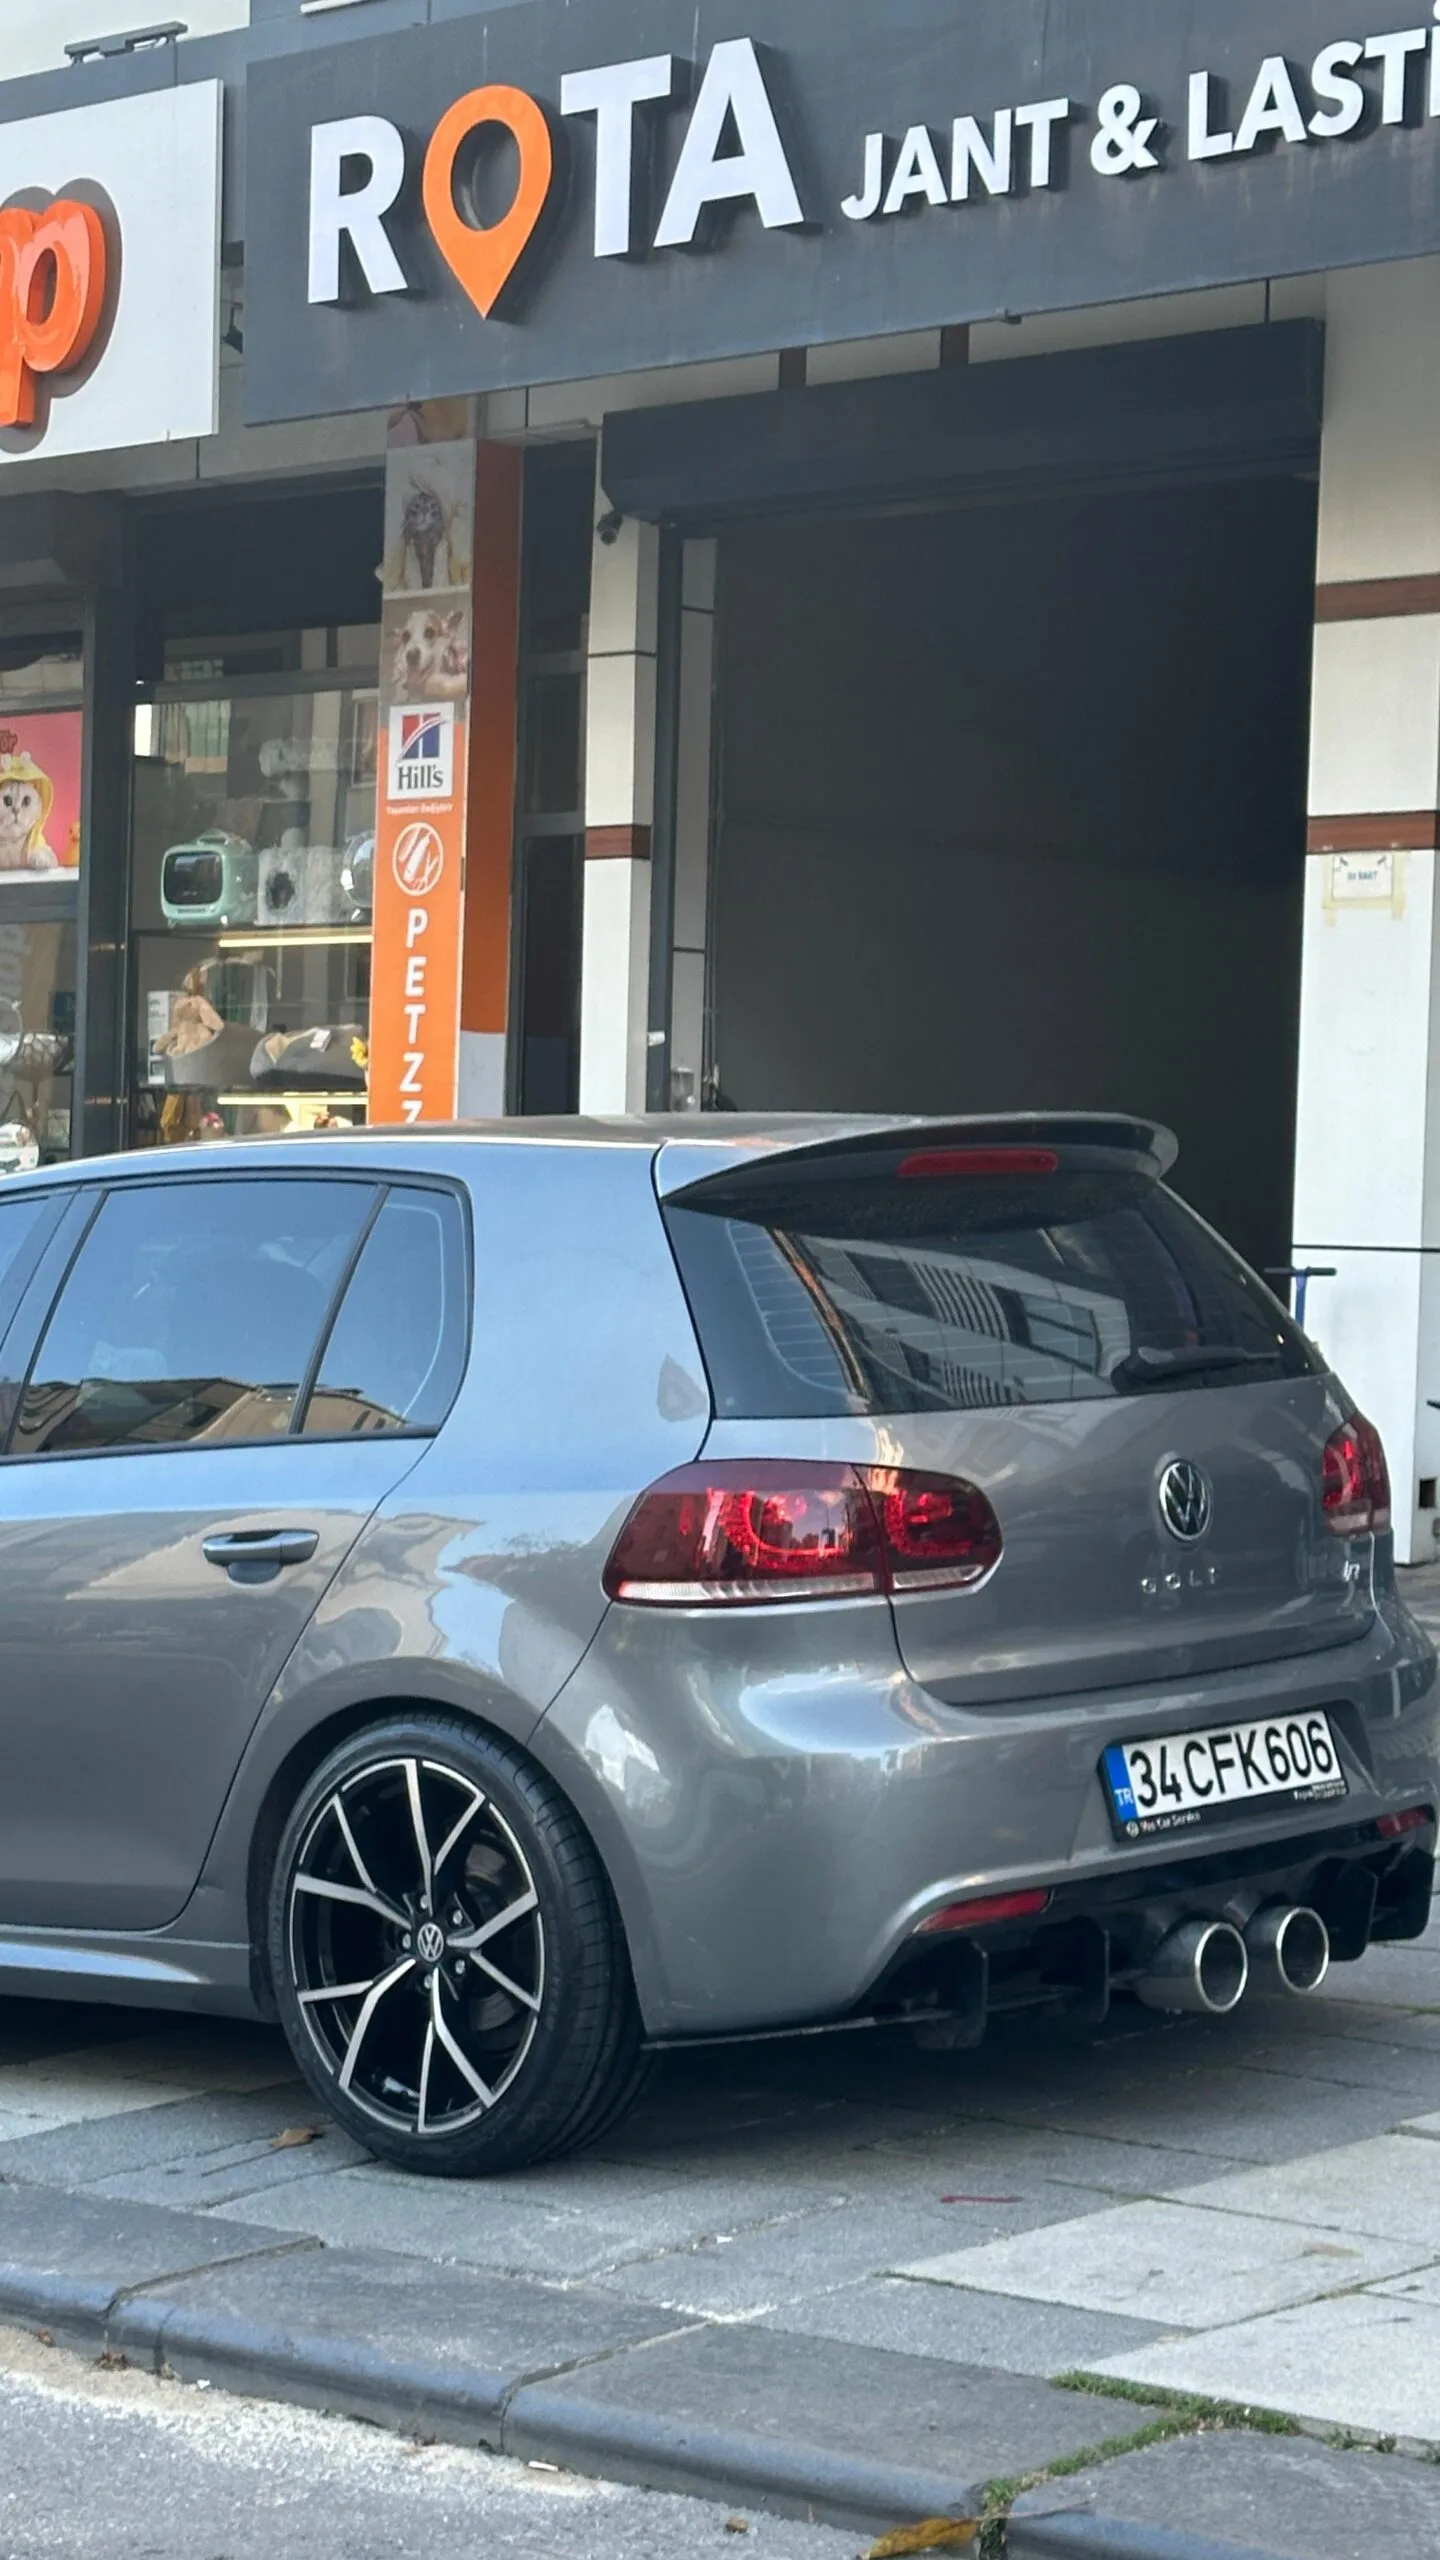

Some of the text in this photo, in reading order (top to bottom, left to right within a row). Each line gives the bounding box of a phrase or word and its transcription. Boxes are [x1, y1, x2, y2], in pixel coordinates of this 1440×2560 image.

[308, 40, 804, 320] ROTA
[841, 98, 1069, 220] JANT
[1091, 84, 1159, 175] &
[397, 764, 444, 791] Hill's
[1115, 1788, 1135, 1807] TR
